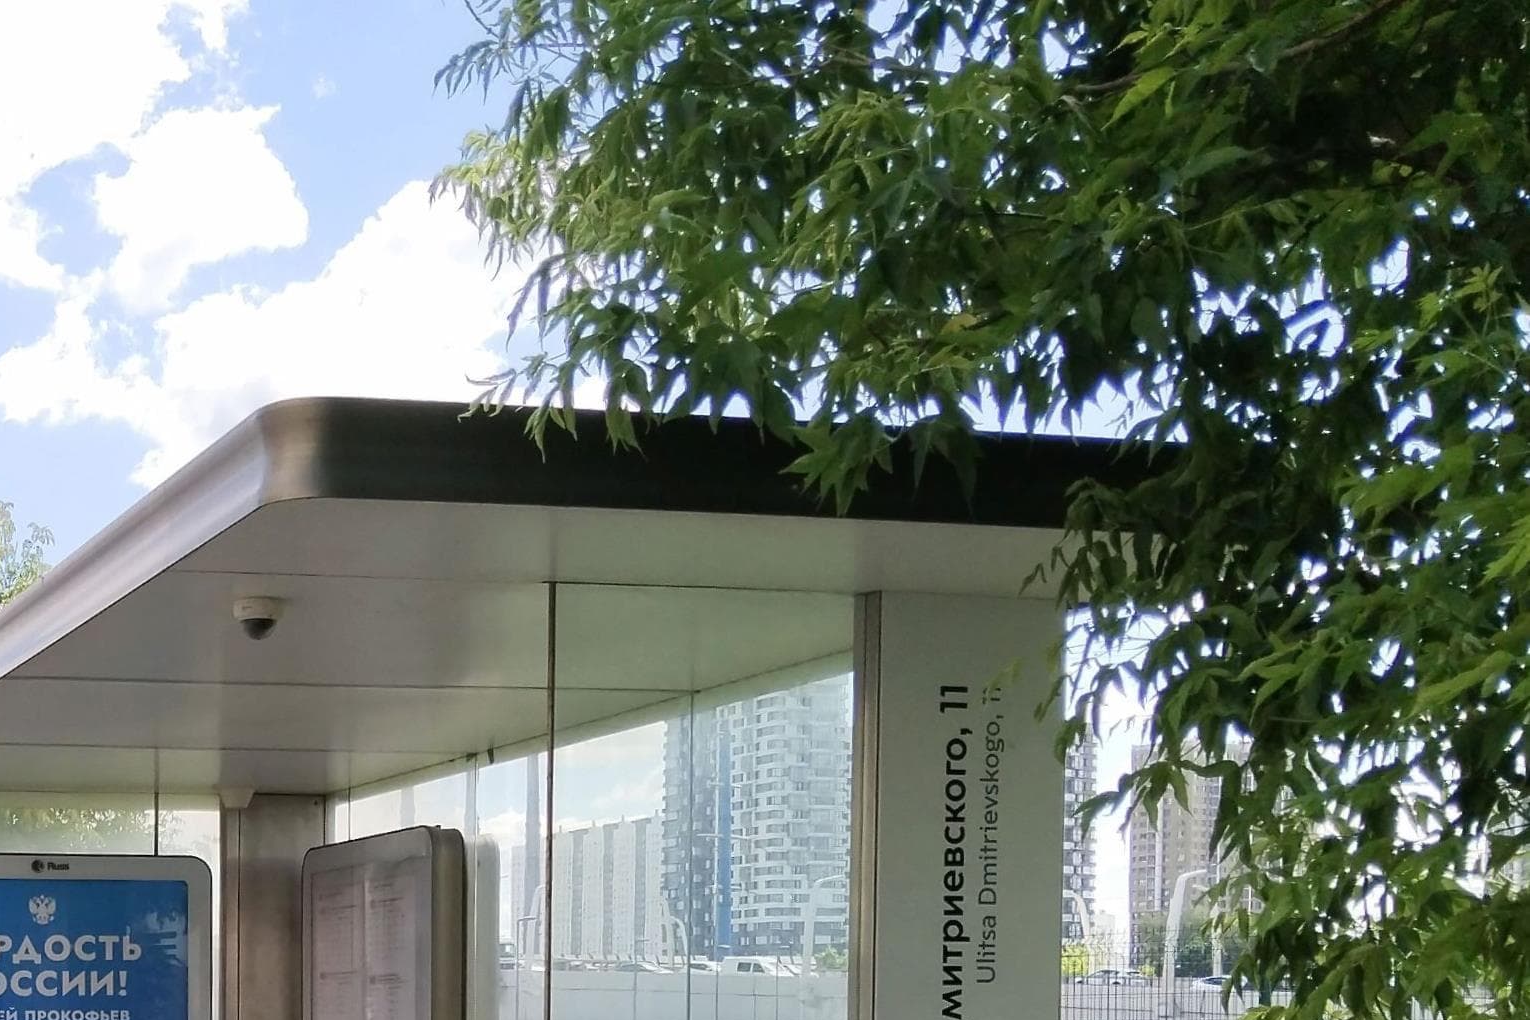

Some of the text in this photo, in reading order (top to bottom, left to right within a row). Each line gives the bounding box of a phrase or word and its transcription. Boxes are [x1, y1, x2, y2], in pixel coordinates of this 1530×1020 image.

[939, 685, 969, 714] 11
[978, 713, 1005, 906] Dmitrievskogo,
[976, 914, 998, 984] Ulitsa
